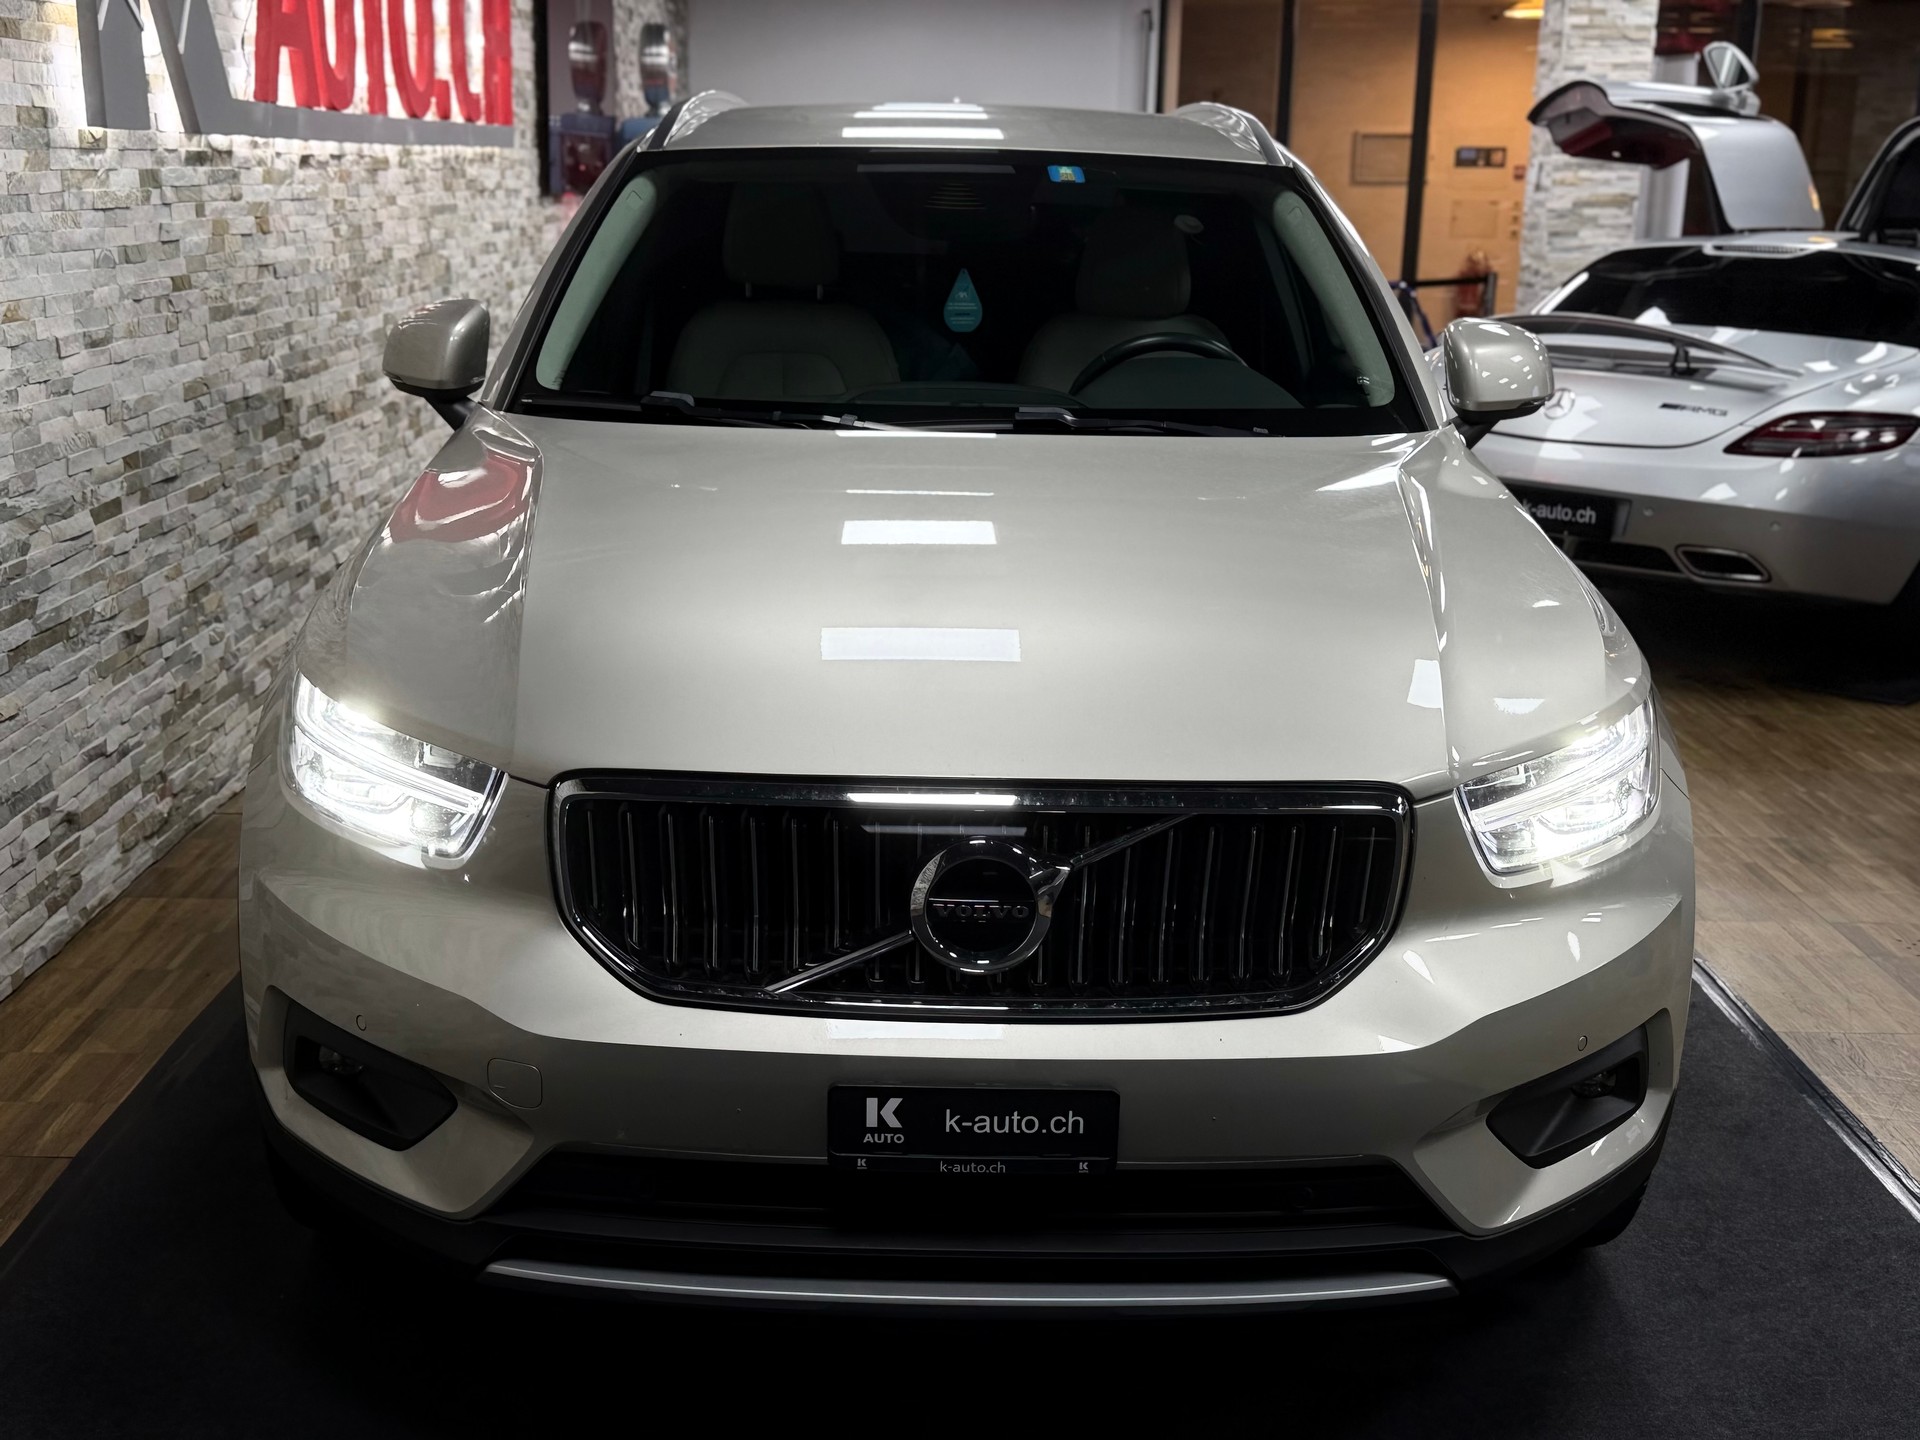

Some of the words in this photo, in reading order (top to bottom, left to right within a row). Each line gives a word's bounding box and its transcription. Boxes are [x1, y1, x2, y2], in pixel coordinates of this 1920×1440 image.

[932, 903, 1030, 919] VOLVO
[866, 1097, 904, 1128] K
[945, 1108, 1085, 1134] k-auto.ch
[863, 1133, 905, 1144] AUTO
[939, 1160, 1006, 1174] k-auto.ch
